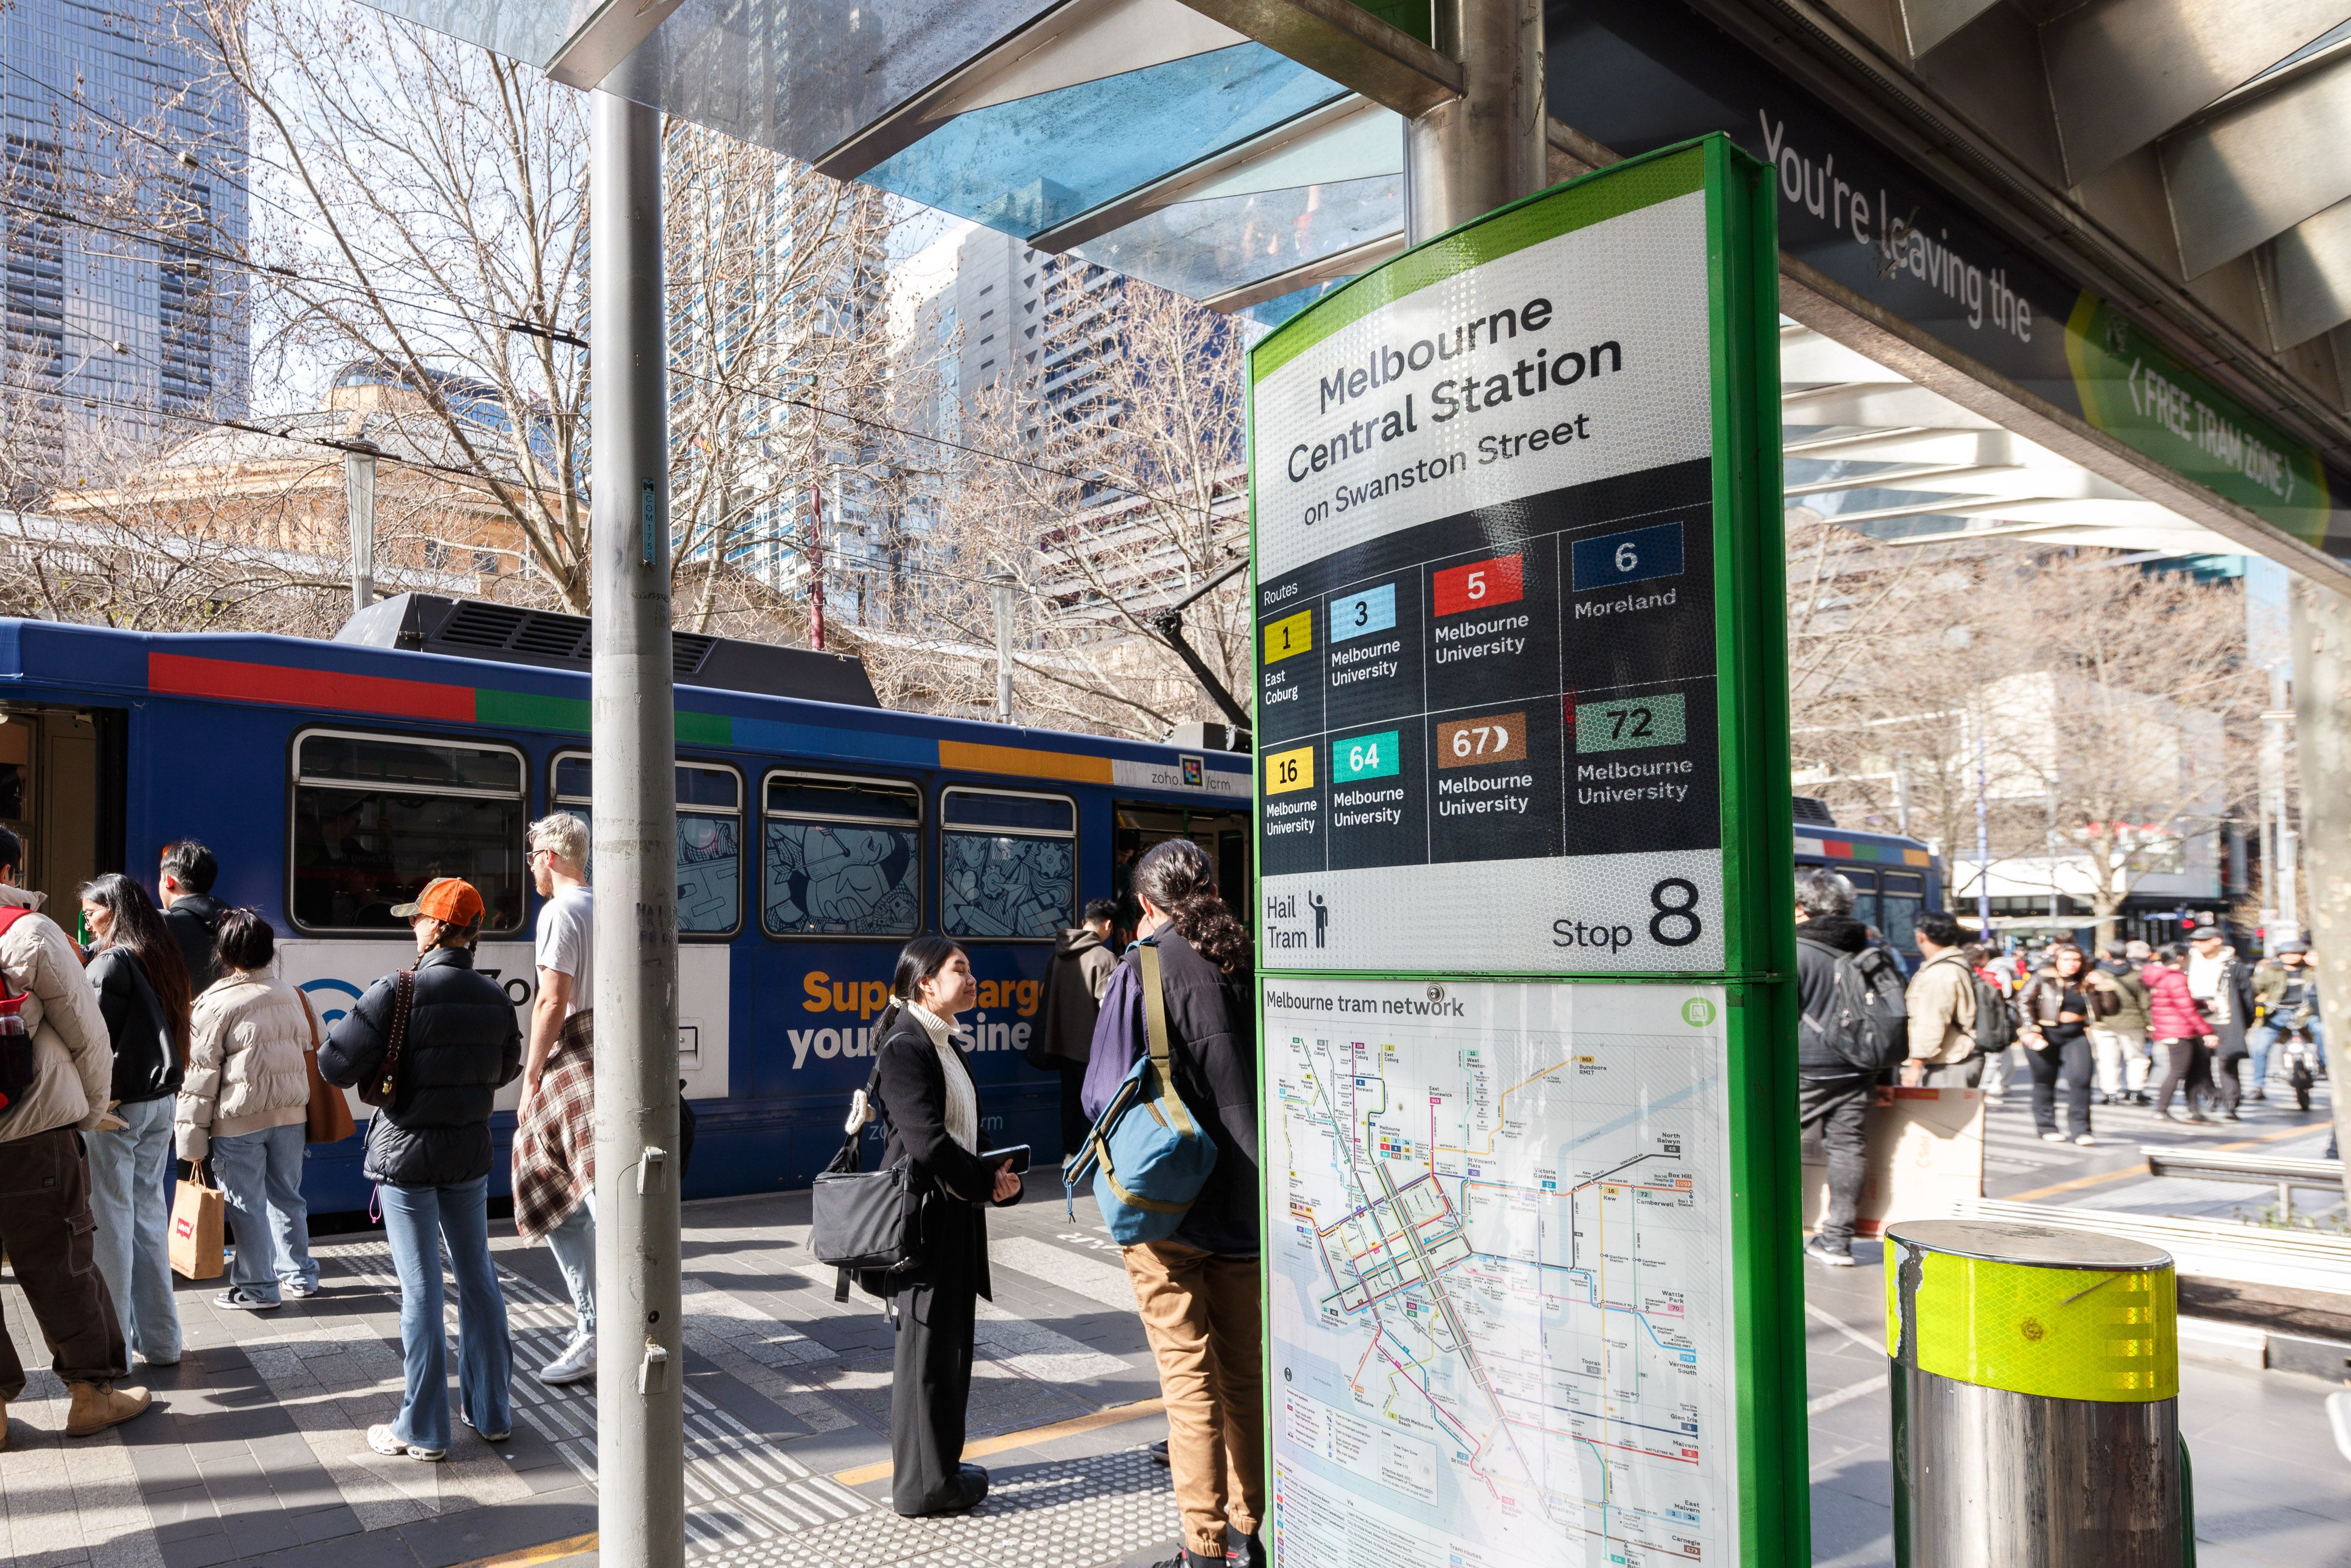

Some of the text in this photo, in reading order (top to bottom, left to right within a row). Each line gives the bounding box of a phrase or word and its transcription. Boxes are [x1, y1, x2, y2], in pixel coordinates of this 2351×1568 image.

[1760, 109, 2031, 343] You're leaving the
[1320, 297, 1553, 414] Melbourne
[1288, 340, 1621, 483] Central Station
[2145, 368, 2283, 497] FREE TRAM ZONE
[1305, 414, 1589, 525] on Swanston Street
[1615, 542, 1637, 572] 6
[1264, 581, 1298, 607] Routes
[1468, 571, 1485, 599] 5
[1355, 601, 1368, 626] 3
[1575, 589, 1676, 619] Moreland
[1282, 627, 1291, 649] 1
[1435, 614, 1529, 643] Melbourne
[1331, 639, 1400, 668] Melbourne
[1436, 635, 1525, 664] University
[1265, 670, 1285, 688] East
[1332, 661, 1398, 686] University
[1265, 685, 1298, 706] Coburg
[1609, 708, 1652, 739] 72
[1349, 745, 1379, 772] 64
[1578, 758, 1693, 782] Melbourne
[1279, 759, 1297, 783] 16
[1439, 774, 1532, 795] Melbourne
[1578, 782, 1688, 805] University
[1266, 799, 1317, 818] Melbourne
[1334, 787, 1404, 807] Melbourne
[1439, 796, 1529, 816] University
[1266, 819, 1315, 836] University
[1335, 808, 1401, 827] University
[1267, 896, 1296, 920] Hail
[1553, 877, 1702, 954] Stop 8
[1267, 926, 1307, 950] Tram
[1267, 991, 1465, 1017] Melbourne tram network
[1620, 1155, 1638, 1165] DONCASTER
[1636, 1199, 1674, 1207] Camberwell
[1321, 1314, 1348, 1326] Victoria Harbour
[1582, 1358, 1601, 1366] Toorak
[1669, 1361, 1697, 1370] Vermont
[1354, 1398, 1374, 1408] Melbourne
[1398, 1415, 1411, 1423] South
[1411, 1419, 1434, 1430] Melbourne
[1645, 1447, 1668, 1455] WATTLETREE
[1673, 1440, 1699, 1450] Malvern
[1674, 1503, 1700, 1513] Malvern
[1449, 1543, 1482, 1560] Tram routes
[1672, 1535, 1700, 1546] Carnegie
